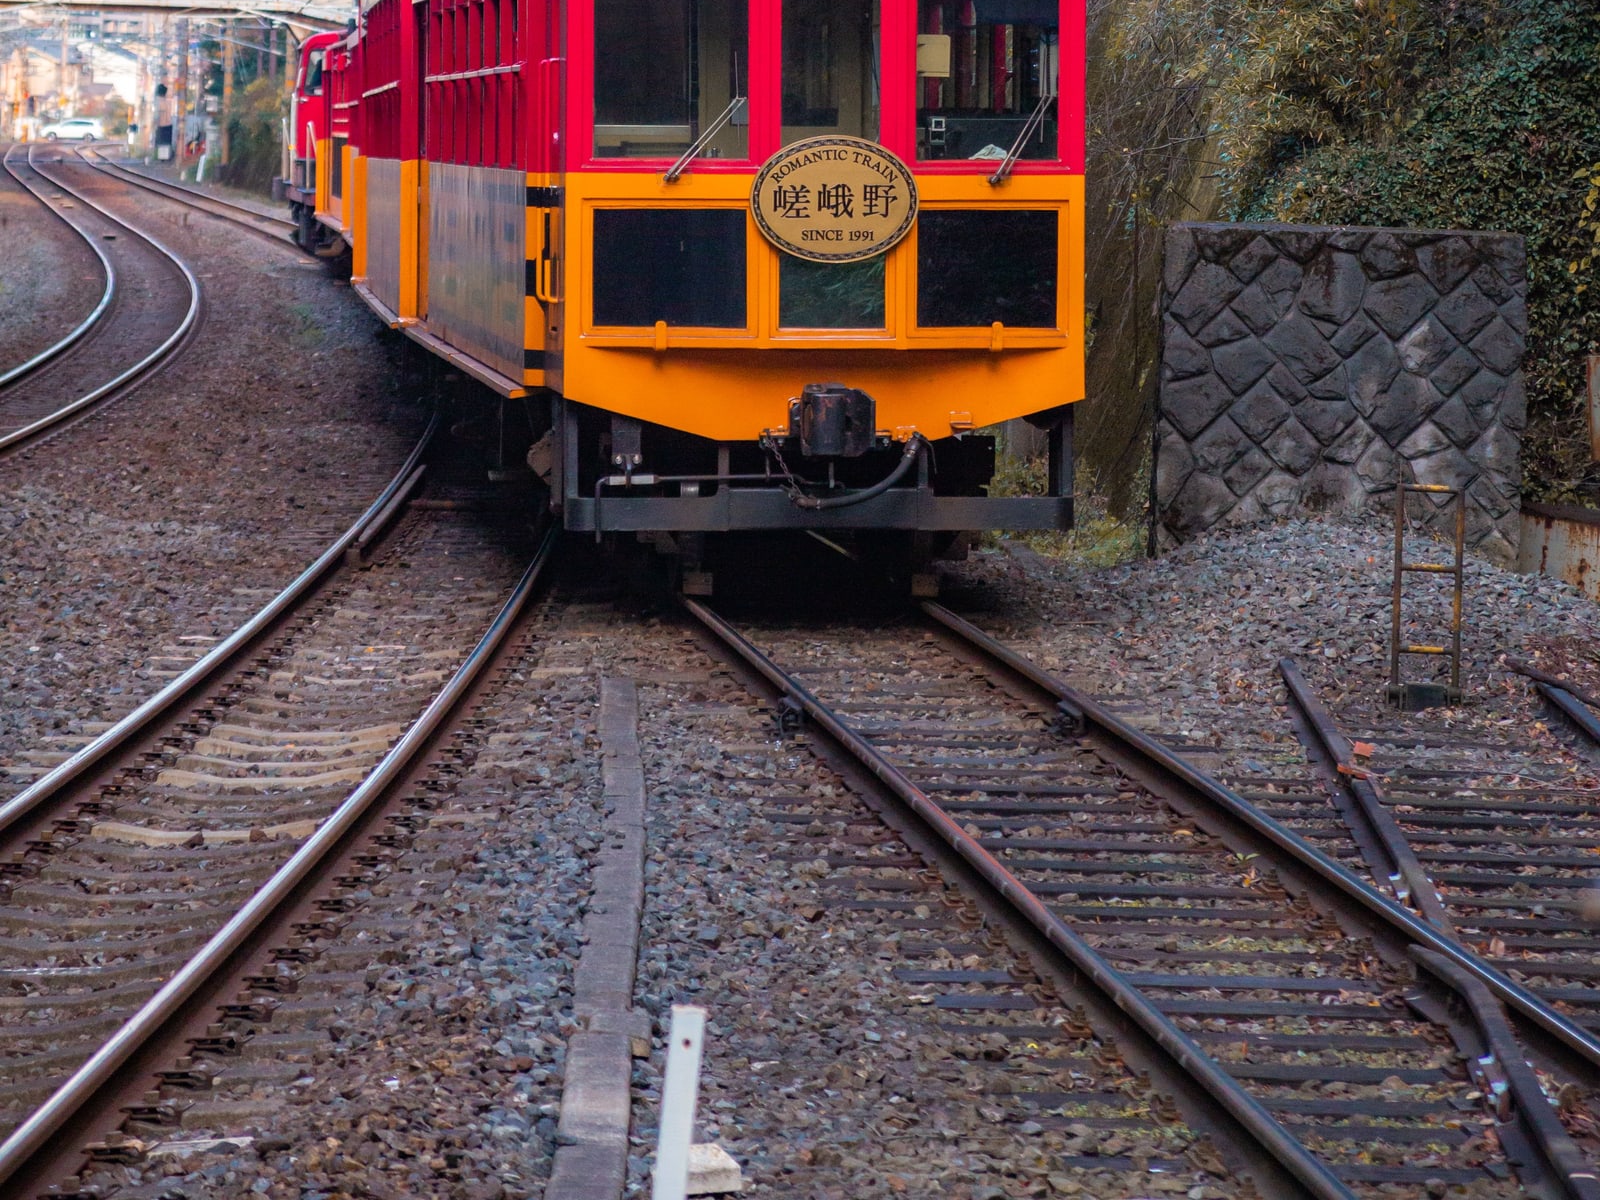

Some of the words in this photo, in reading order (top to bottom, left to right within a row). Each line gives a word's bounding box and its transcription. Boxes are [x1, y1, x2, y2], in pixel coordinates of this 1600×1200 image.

[770, 149, 848, 184] ROMANTIC
[853, 151, 898, 183] TRAIN
[773, 183, 898, 219] 嵯峨野
[801, 229, 843, 241] SINCE
[849, 230, 874, 241] 1991
